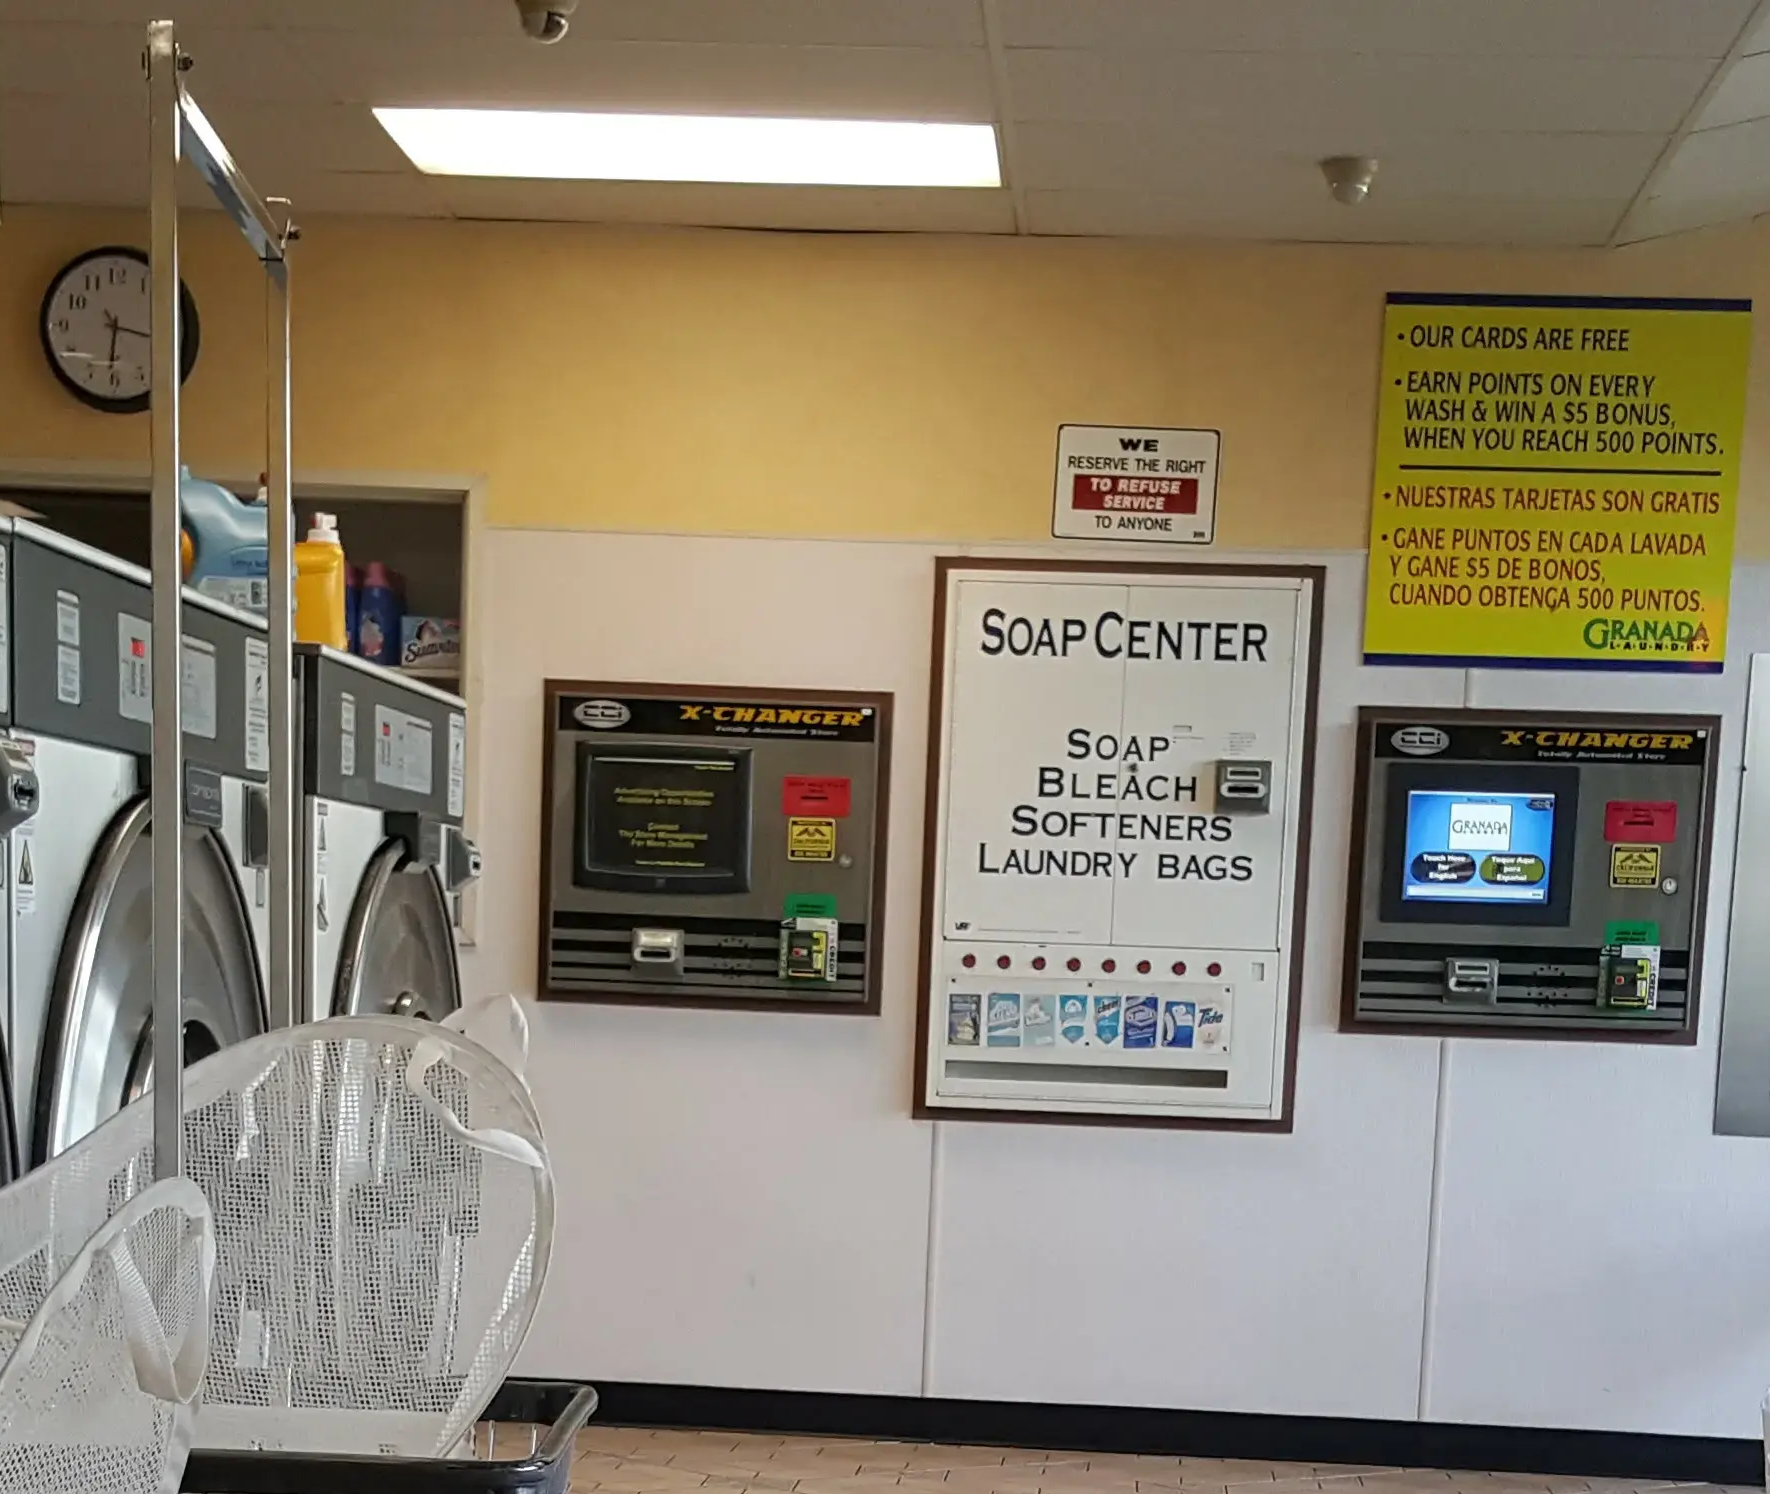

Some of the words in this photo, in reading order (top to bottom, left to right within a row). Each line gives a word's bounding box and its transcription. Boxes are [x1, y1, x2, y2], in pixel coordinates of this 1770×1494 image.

[85, 274, 100, 291] 11
[109, 267, 127, 285] 12
[69, 293, 87, 310] 10
[1410, 325, 1454, 348] OUR
[1462, 325, 1528, 350] CARDS
[1533, 328, 1573, 350] ARE
[1581, 329, 1629, 351] FREE
[1407, 371, 1461, 394] EARN
[1468, 372, 1543, 396] POINTS
[1550, 374, 1581, 396] ON
[1589, 375, 1656, 398] EVERY
[1405, 399, 1464, 422] WASH
[1472, 400, 1487, 422] &
[1495, 400, 1535, 423] WIN
[1541, 402, 1556, 424] A
[1595, 403, 1676, 429] BONUS,
[1119, 438, 1159, 452] WE
[1404, 426, 1466, 449] WHEN
[1472, 428, 1515, 451] YOU
[1522, 429, 1588, 452] REACH
[1596, 430, 1634, 453] 500
[1641, 431, 1724, 455] POINTS.
[1068, 455, 1128, 471] RESERVE
[1135, 458, 1160, 472] THE
[1165, 459, 1206, 473] RIGHT
[1090, 477, 1112, 491] TO
[1117, 479, 1181, 494] REFUSE
[1103, 494, 1165, 510] SERVICE
[1396, 485, 1496, 509] NUESTRAS
[1503, 488, 1596, 512] TARJETAS
[1601, 490, 1644, 513] SON
[1651, 491, 1720, 515] GRATIS
[1095, 515, 1112, 529] TO
[1117, 517, 1172, 531] ANYONE
[1393, 527, 1445, 550] GANE
[1452, 528, 1531, 552] PUNTOS
[1538, 531, 1563, 552] EN
[1569, 532, 1624, 554] CADA
[1630, 532, 1707, 556] LAVADA
[1390, 556, 1402, 577] Y
[1407, 556, 1459, 579] GANE
[1497, 558, 1522, 580] DE
[1529, 559, 1605, 585] BONOS,
[1389, 583, 1471, 607] CUANDO
[1479, 584, 1570, 610] OBTENGA
[1578, 588, 1614, 610] 500
[1621, 590, 1705, 613] PUNTOS.
[981, 608, 1087, 656] SOAP
[1094, 611, 1268, 662] CENTER
[1583, 617, 1709, 650] GRANADA
[680, 704, 866, 727] X-CHANGER
[1067, 728, 1170, 761] SOAP
[1500, 730, 1694, 749] X-CHANGER
[1038, 766, 1196, 802] BLEACH
[1011, 804, 1233, 842] SOFTENERS
[1452, 819, 1508, 834] GRANADA
[979, 842, 1138, 878] LAUNDRY
[1157, 853, 1253, 881] BAGS
[1197, 1008, 1224, 1028] Tide
